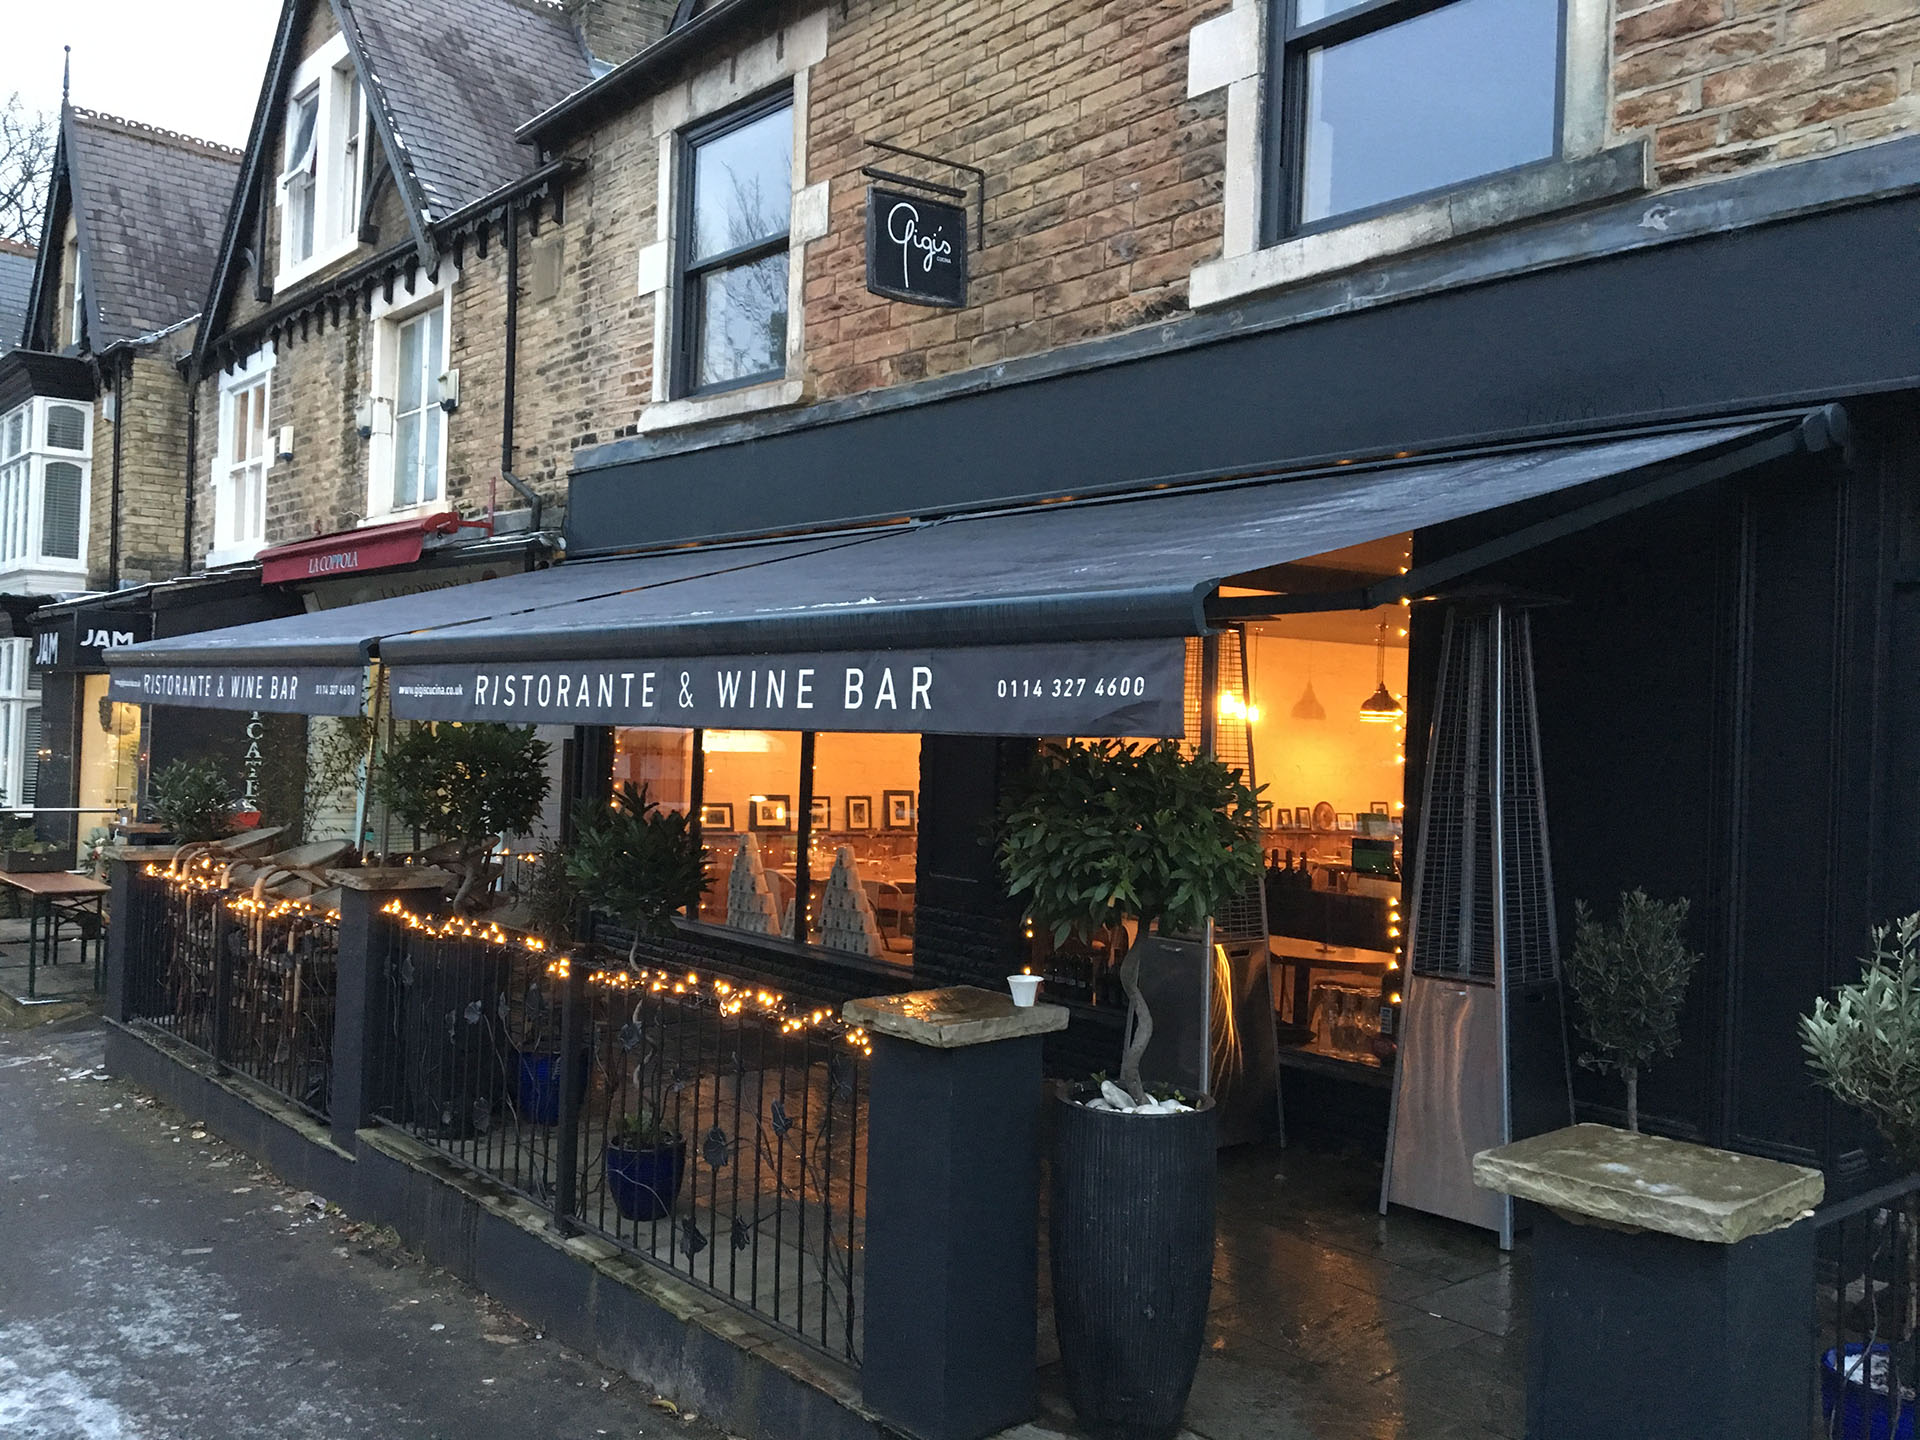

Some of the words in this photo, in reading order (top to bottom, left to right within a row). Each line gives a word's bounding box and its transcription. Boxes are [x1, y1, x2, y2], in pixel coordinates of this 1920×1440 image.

[888, 202, 951, 288] Gigi's
[308, 558, 319, 574] LA
[319, 551, 359, 572] COPPOLA
[36, 632, 59, 665] JAM
[80, 629, 134, 647] JAM
[143, 674, 212, 697] RISTORANTE
[217, 675, 225, 697] &
[231, 675, 264, 699] WINE
[270, 675, 298, 700] BAR
[475, 672, 656, 707] RISTORANTE
[678, 671, 694, 708] &
[717, 668, 815, 708] WINE
[844, 666, 933, 709] BAR
[997, 679, 1043, 698] 0114
[1051, 678, 1087, 698] 327
[1094, 676, 1145, 697] 4600
